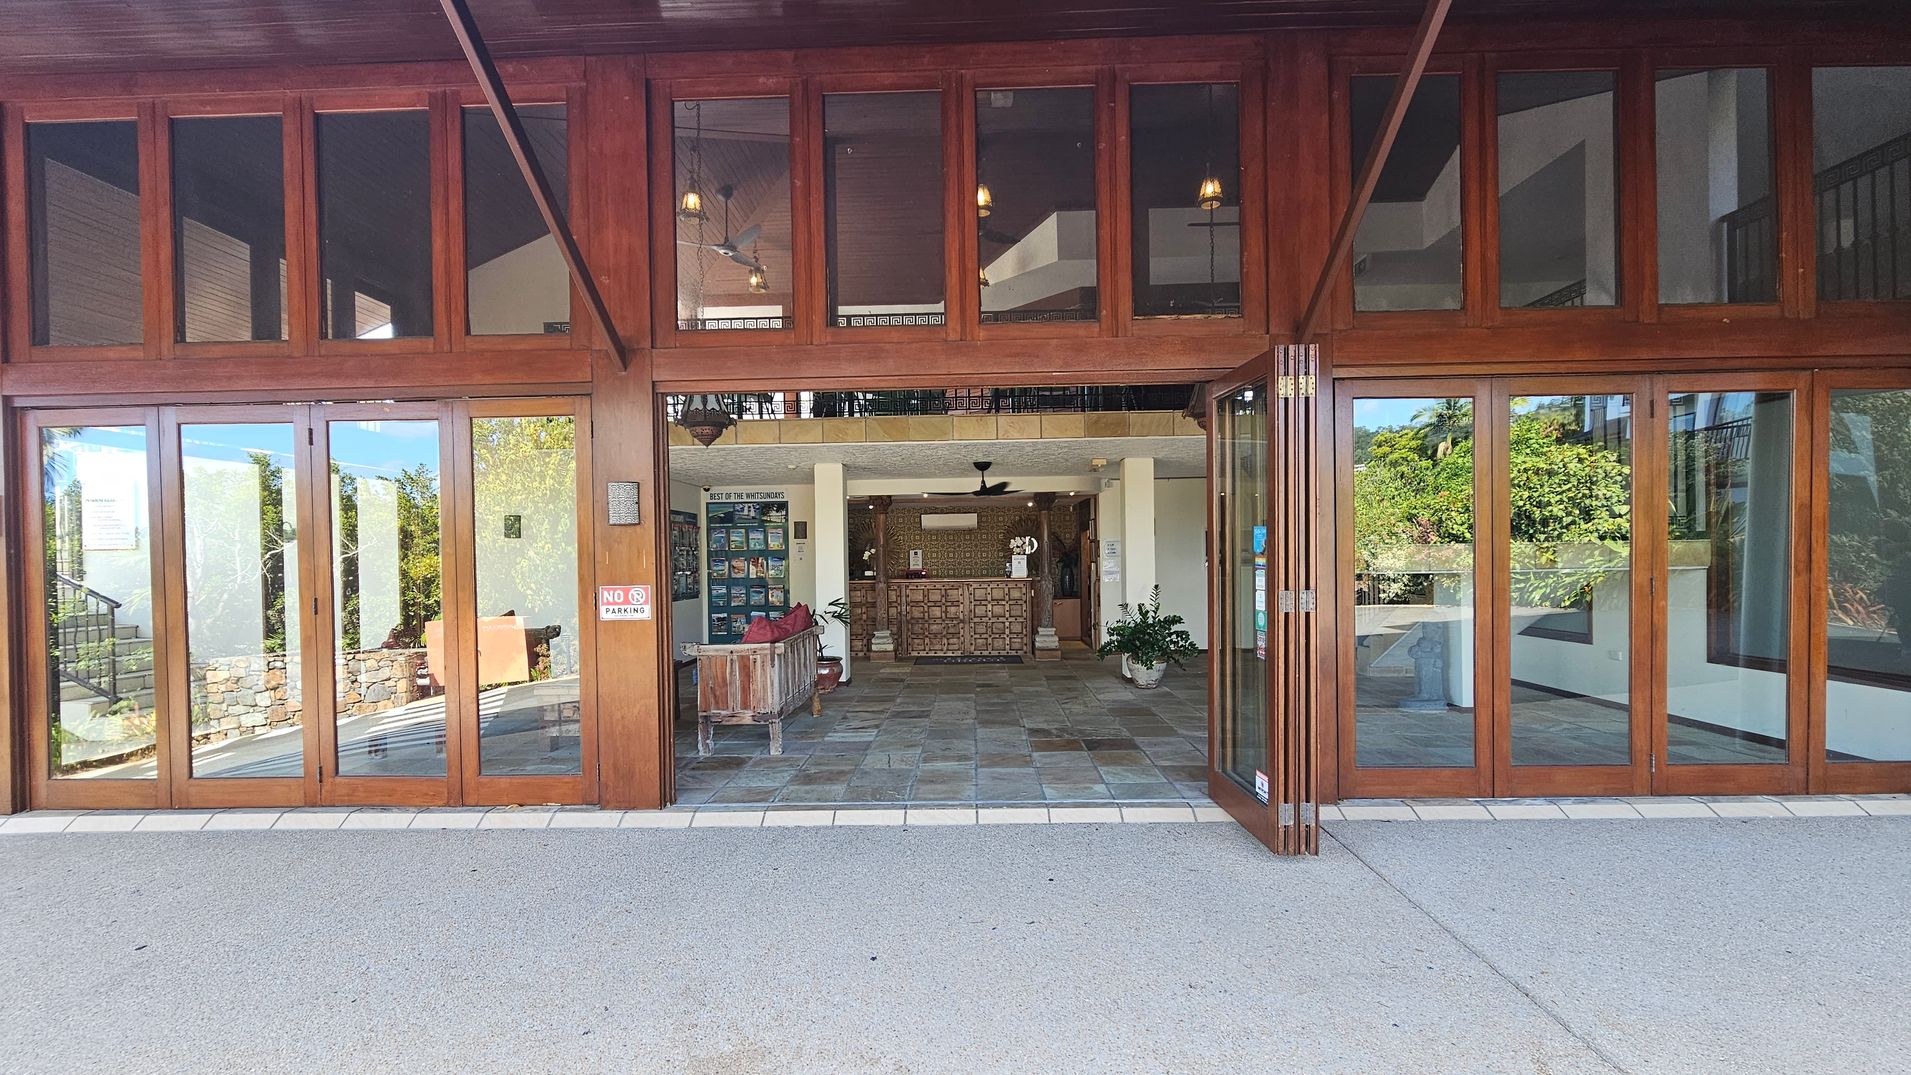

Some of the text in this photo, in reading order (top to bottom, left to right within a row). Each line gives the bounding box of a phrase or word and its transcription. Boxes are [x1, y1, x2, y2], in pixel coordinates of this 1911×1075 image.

[746, 492, 785, 500] WHITSUNDAYS
[603, 590, 624, 603] NO
[605, 607, 645, 615] PARKING
